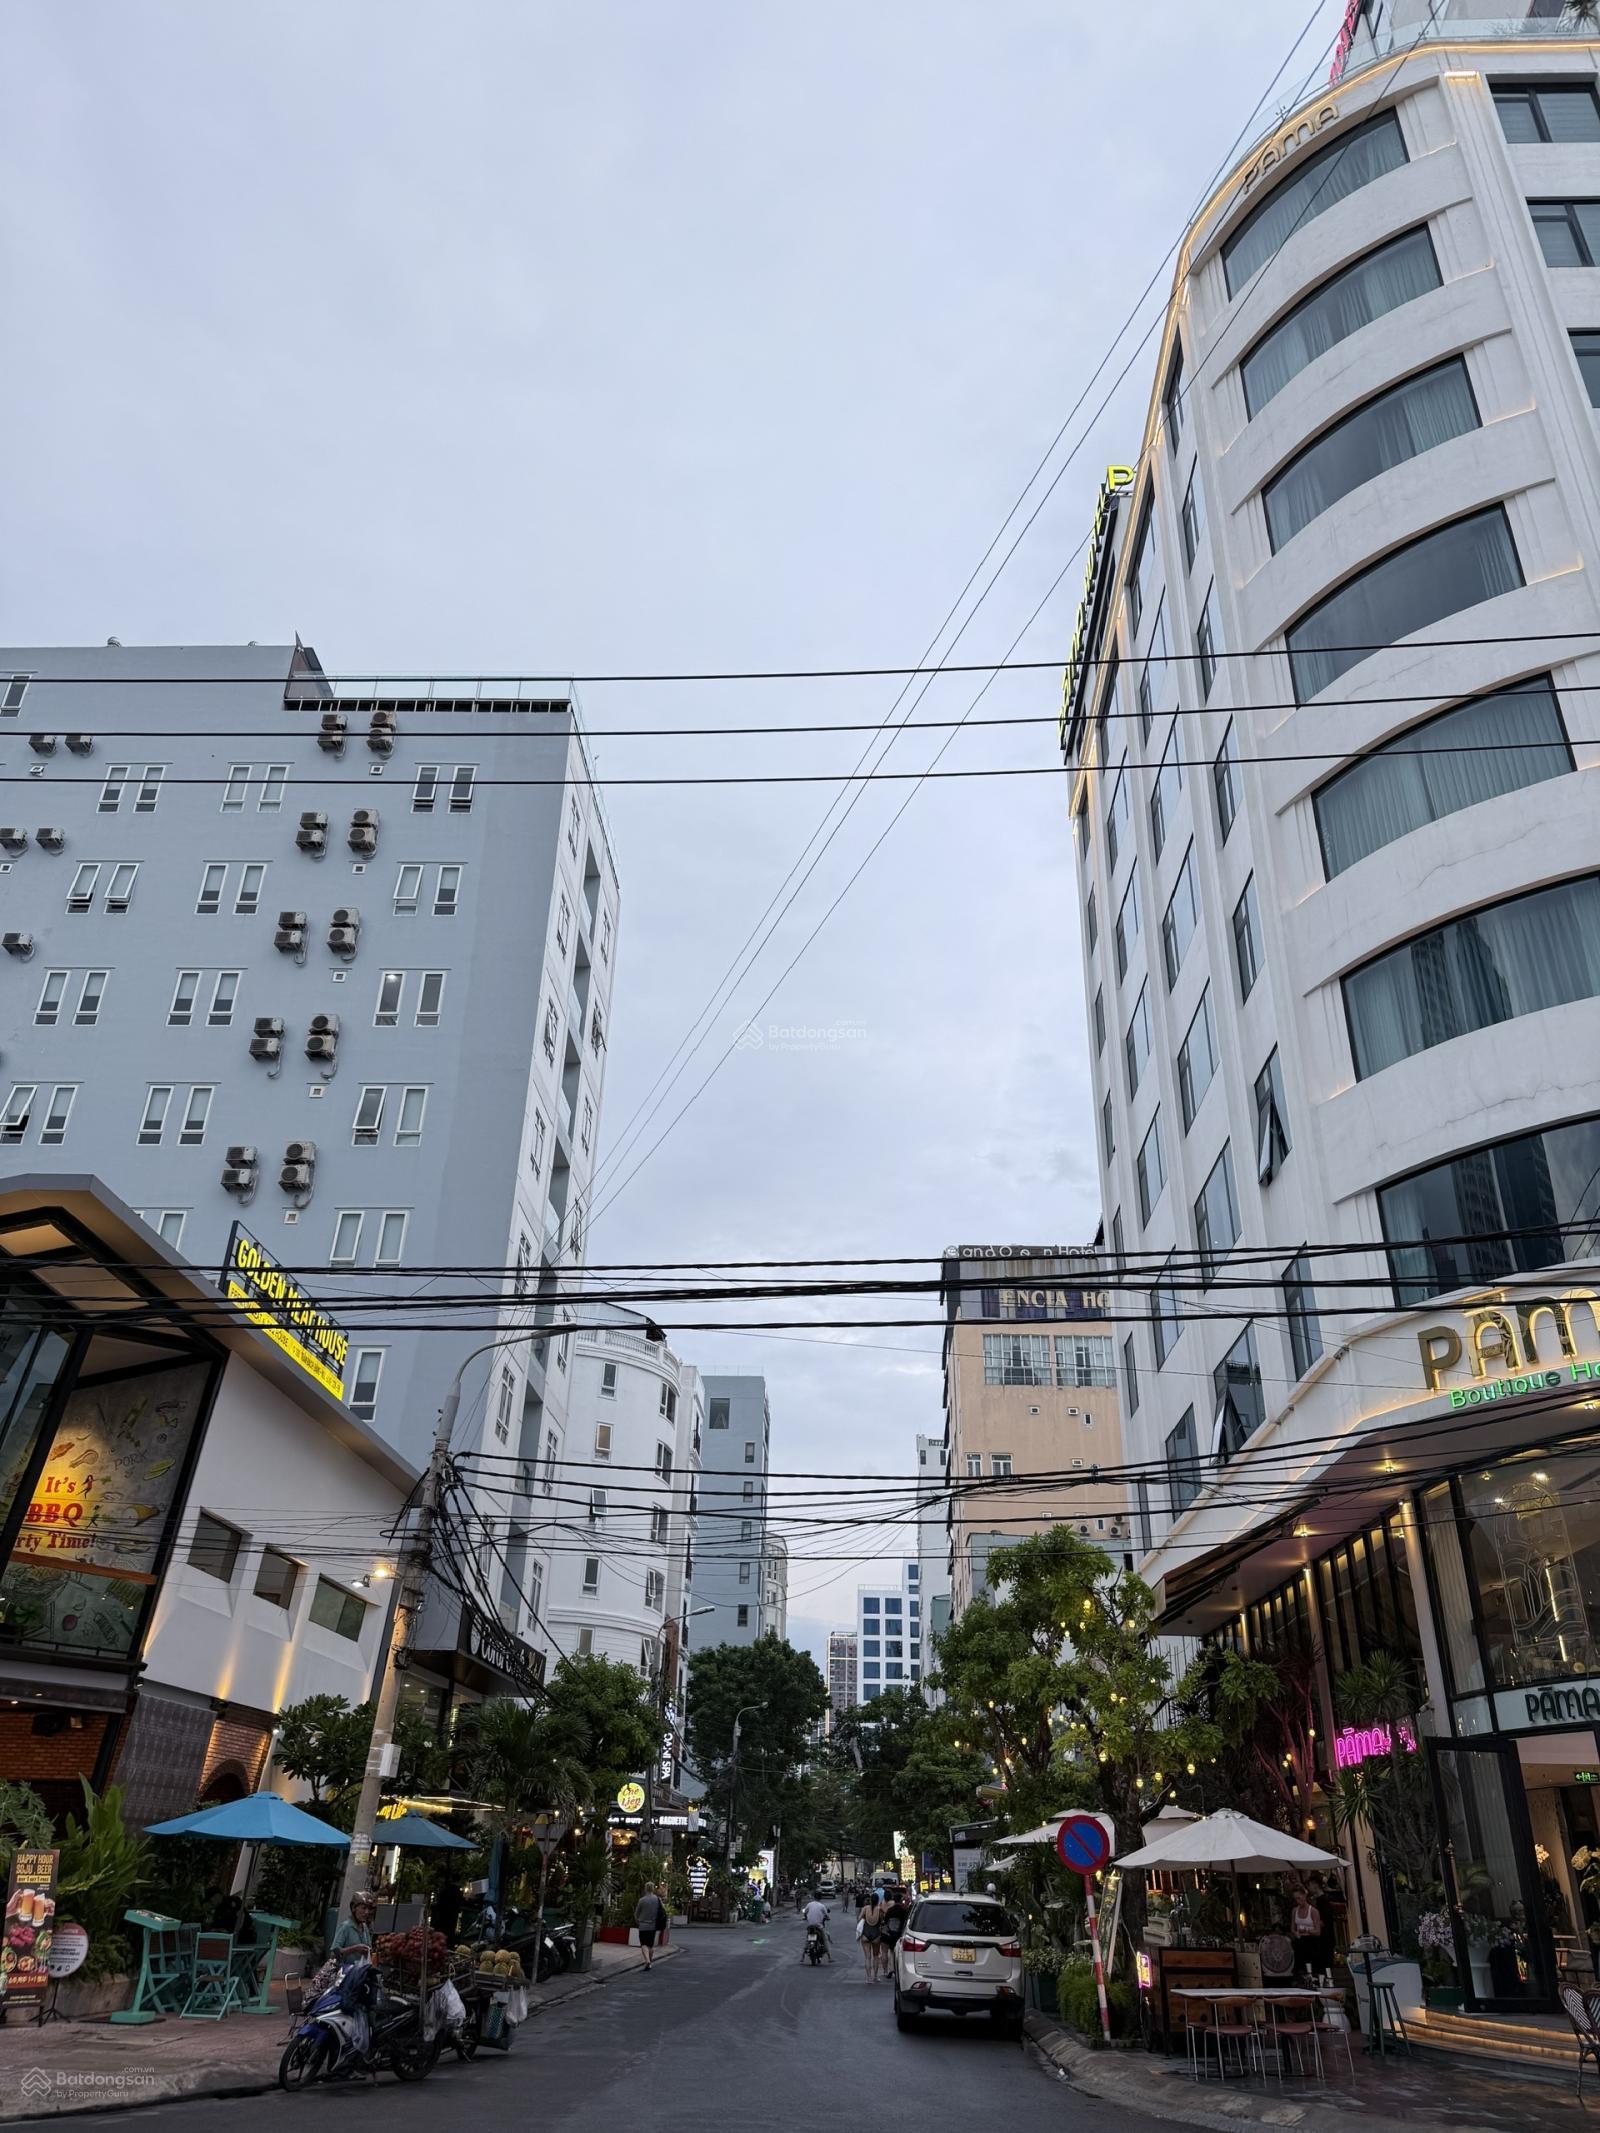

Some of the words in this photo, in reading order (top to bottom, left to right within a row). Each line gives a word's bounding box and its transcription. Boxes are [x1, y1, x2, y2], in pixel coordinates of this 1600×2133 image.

[237, 1239, 286, 1305] GOLDEN
[286, 1286, 316, 1335] MEAT
[314, 1315, 349, 1367] HOUSE
[1449, 1370, 1561, 1409] Boutique
[45, 1476, 76, 1494] It's
[26, 1503, 83, 1527] BBQ
[15, 1533, 41, 1552] rty
[47, 1530, 97, 1549] Time!
[661, 1760, 671, 1780] SPA
[17, 1854, 37, 1864] HAPPY
[37, 1854, 54, 1864] HOUR
[37, 1864, 53, 1875] BEER
